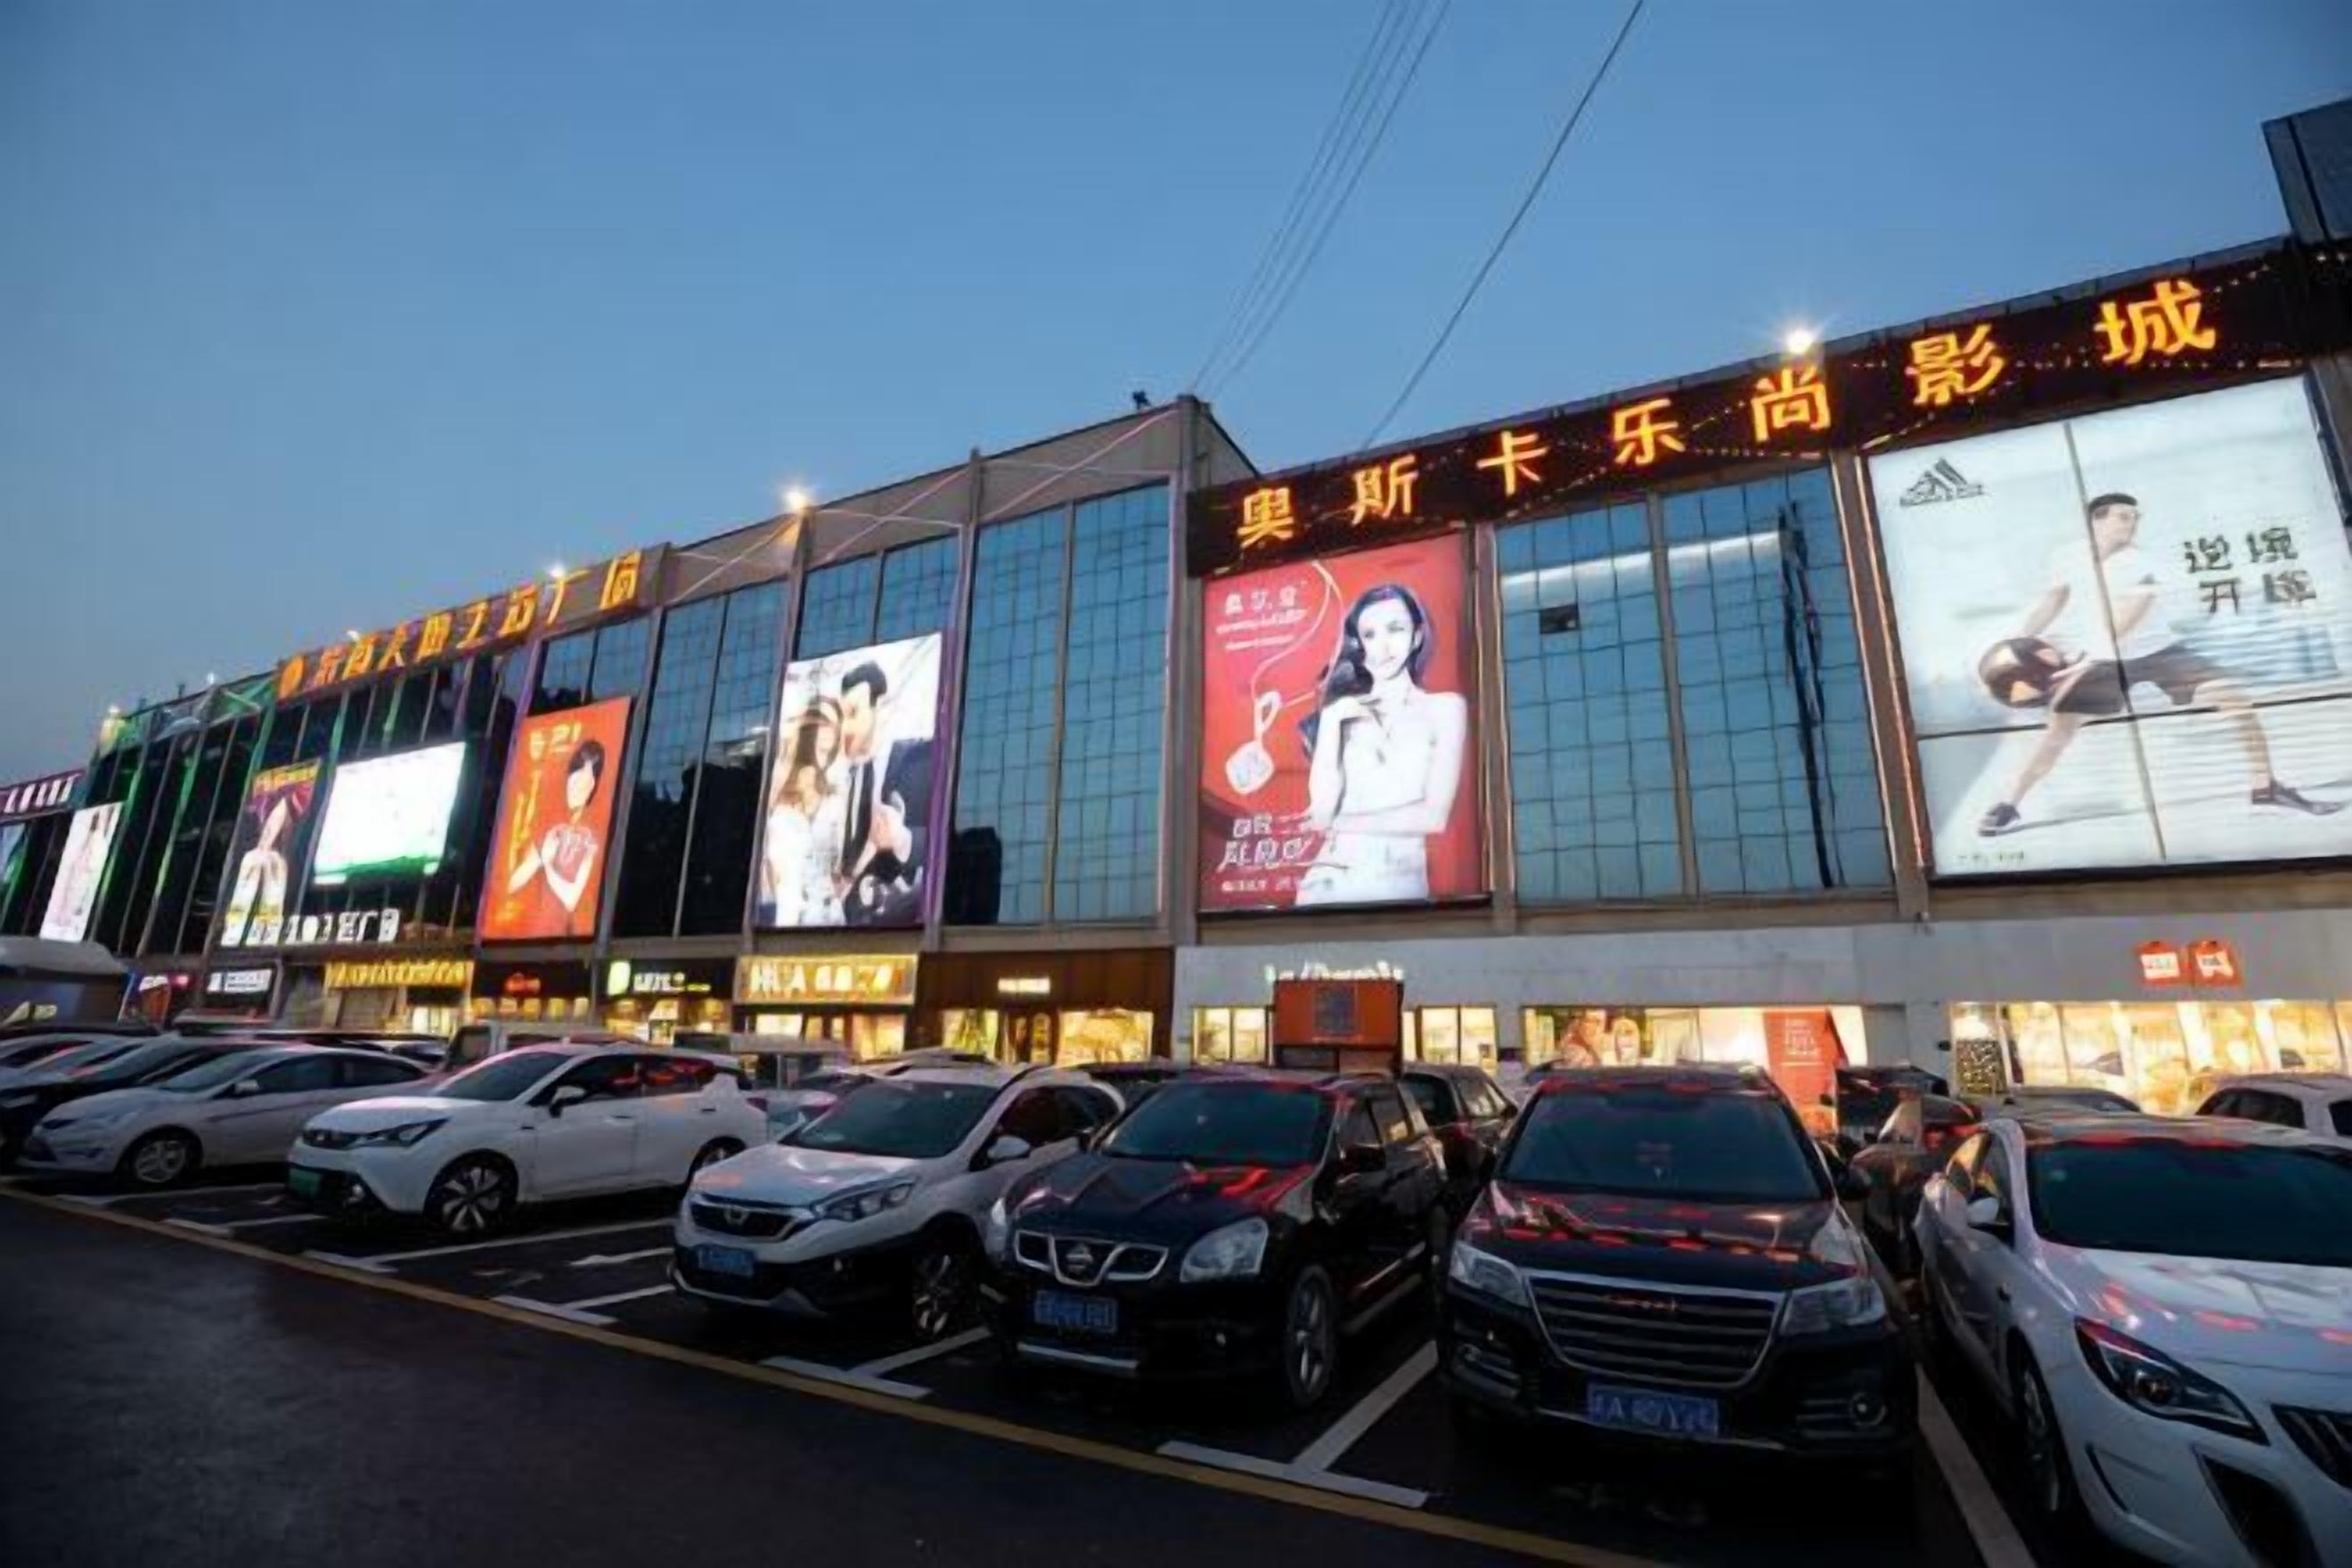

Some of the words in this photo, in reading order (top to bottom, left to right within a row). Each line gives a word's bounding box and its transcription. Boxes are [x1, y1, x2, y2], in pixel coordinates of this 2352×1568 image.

[1237, 279, 2217, 549] 奥斯卡乐尚影城
